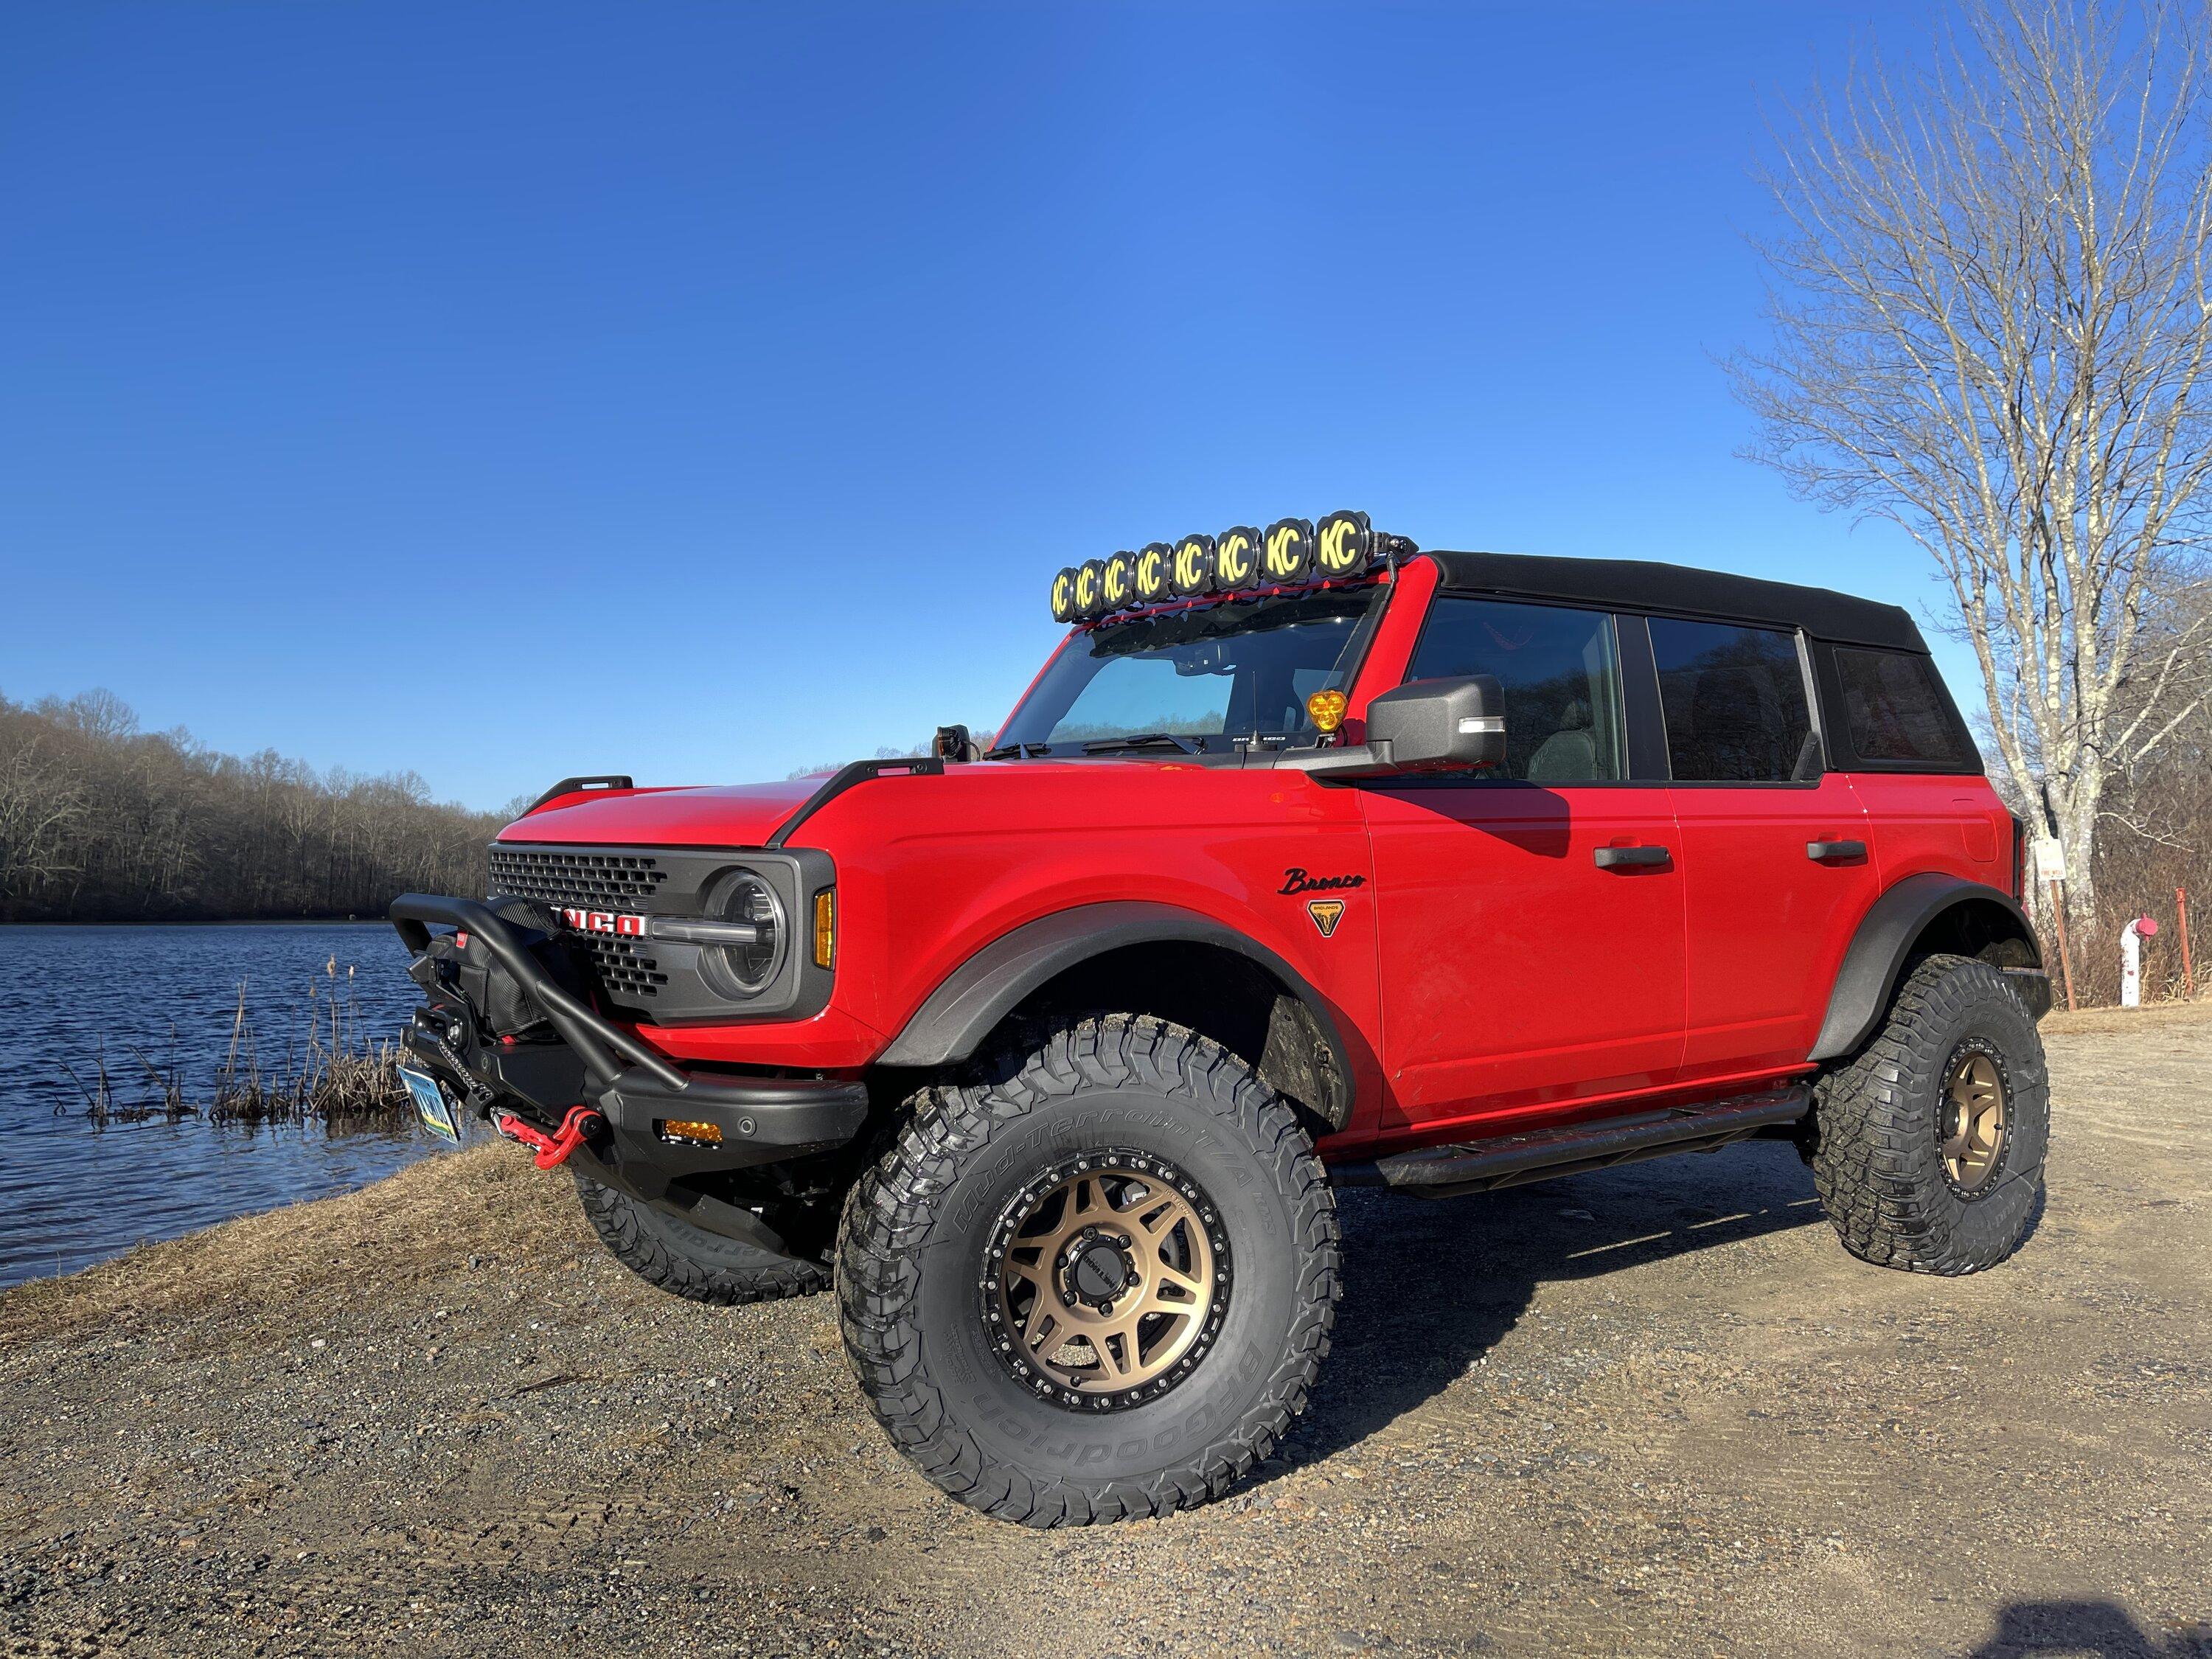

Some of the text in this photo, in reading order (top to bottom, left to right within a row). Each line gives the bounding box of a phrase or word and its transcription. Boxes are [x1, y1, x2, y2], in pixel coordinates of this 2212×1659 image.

[1175, 542, 1202, 588] KC
[1219, 535, 1248, 582] KC
[1267, 526, 1299, 575] KC
[1321, 519, 1356, 569] KC
[1076, 566, 1094, 608] KC
[1104, 558, 1125, 601] KC
[1137, 550, 1161, 594] KC
[1052, 574, 1068, 615] KC
[1276, 868, 1367, 895] Bronco
[550, 906, 645, 936] NCO
[1083, 1255, 1116, 1290] METHOD
[973, 1341, 1266, 1467] BFGoodrich
